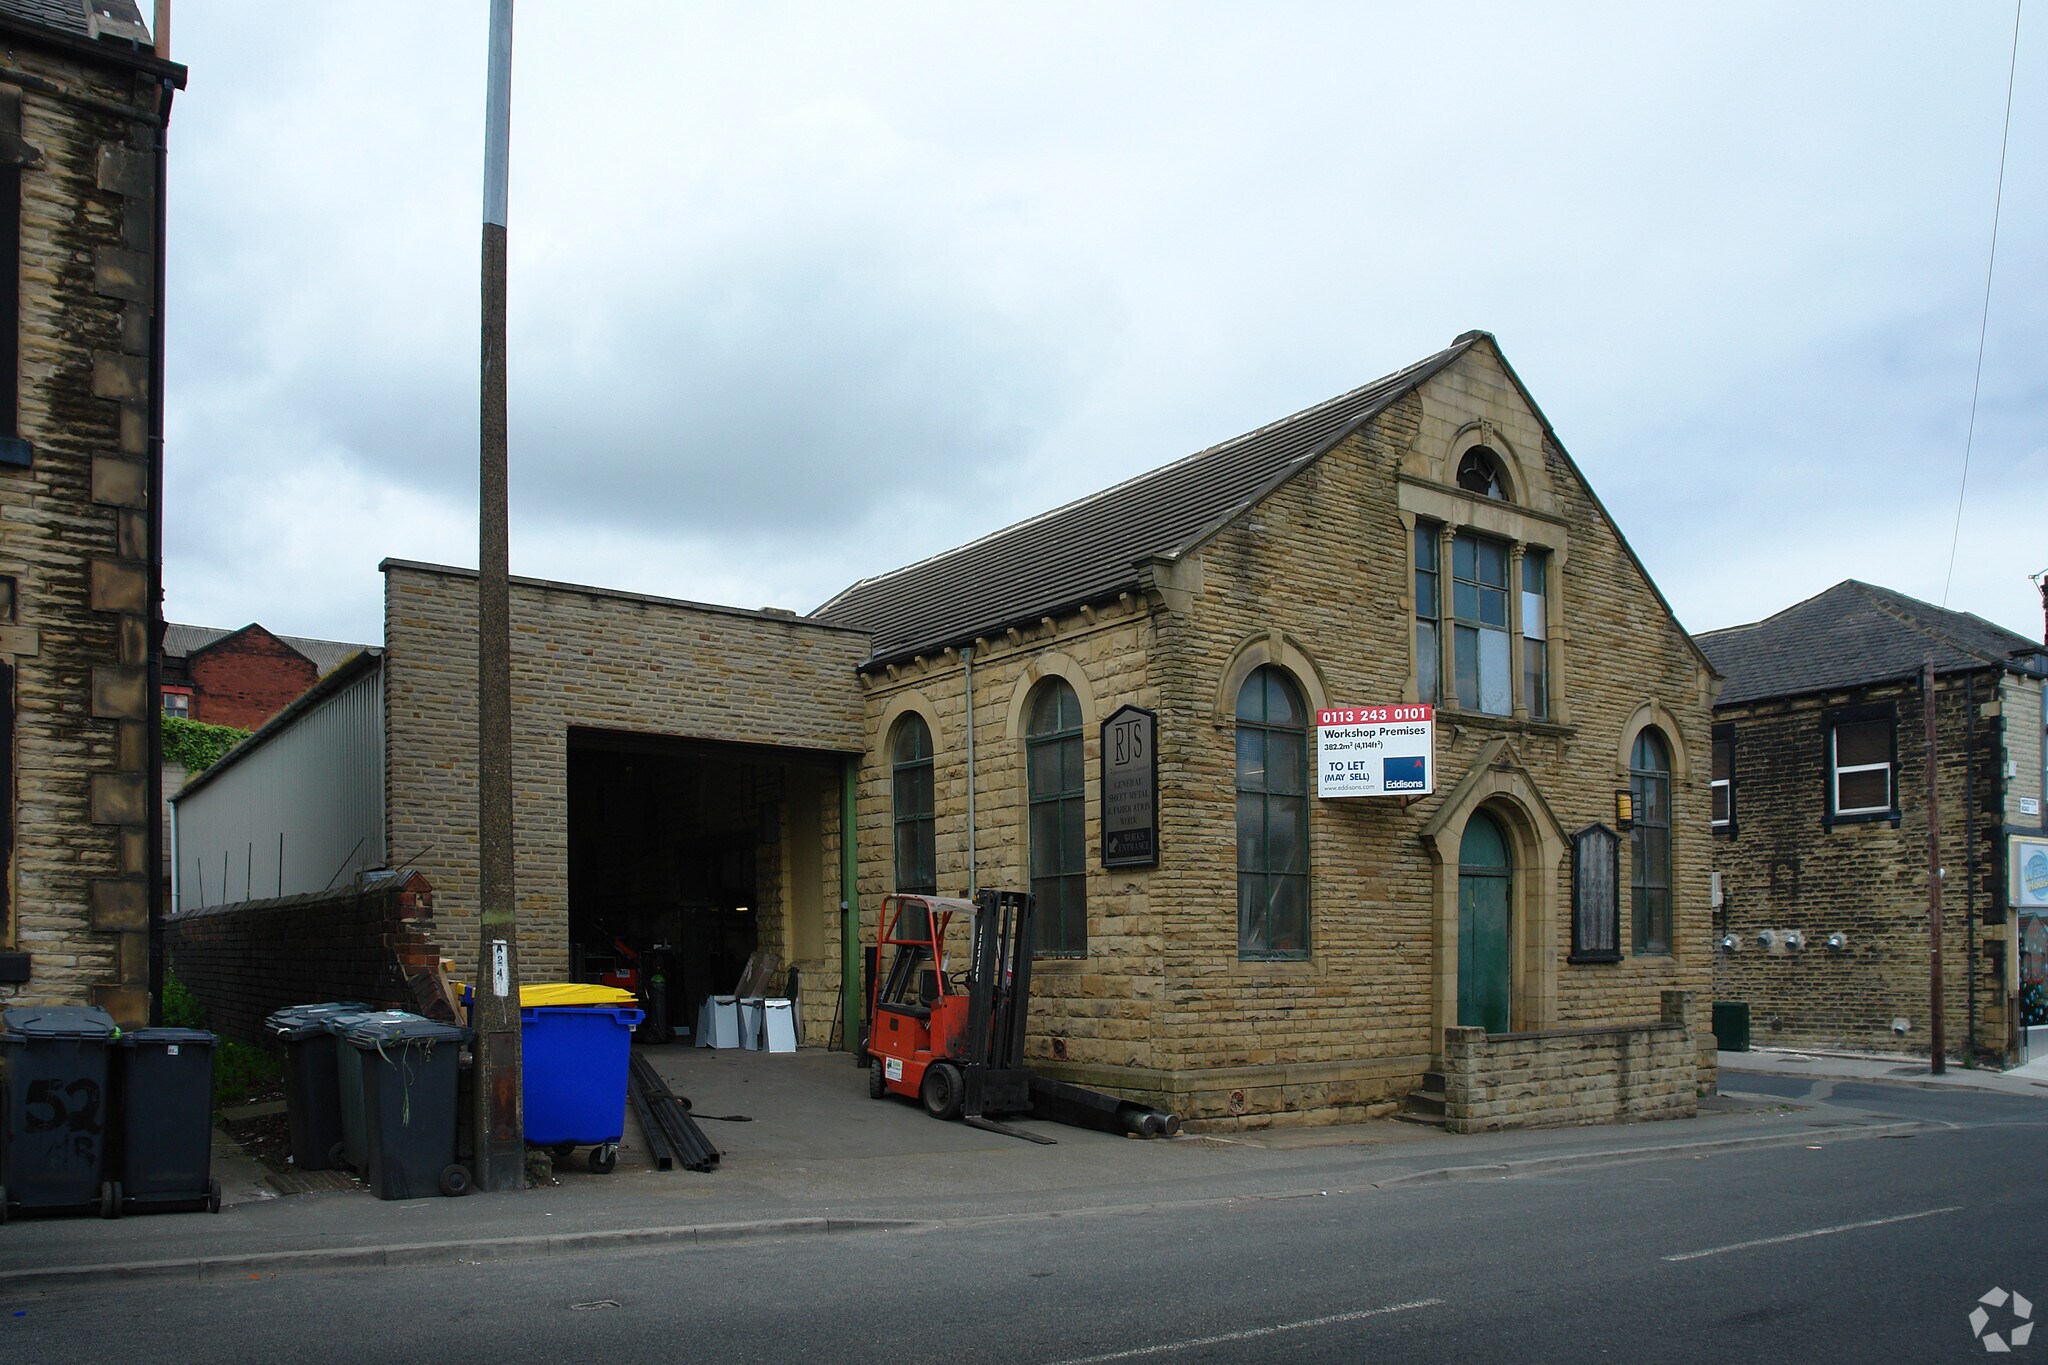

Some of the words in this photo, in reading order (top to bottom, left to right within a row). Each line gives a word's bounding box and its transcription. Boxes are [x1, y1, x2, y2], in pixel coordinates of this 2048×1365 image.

[1322, 711, 1354, 723] 0113
[1360, 709, 1387, 722] 243
[1394, 707, 1425, 720] 0101
[1324, 728, 1376, 739] Workshop
[1379, 726, 1426, 736] Premises
[1329, 761, 1344, 772] TO
[1347, 760, 1365, 771] LET
[1114, 777, 1142, 789] GENERAL
[1324, 774, 1346, 783] (MAY
[1349, 773, 1370, 782] SELL)
[1386, 780, 1424, 789] Eddisons
[1108, 793, 1127, 803] SHEET
[1128, 789, 1149, 801] METAL
[1113, 803, 1151, 815] FABRICATION
[1119, 816, 1138, 825] WORK
[1123, 832, 1145, 842] WORKS
[1118, 842, 1150, 852] ENTRANCE
[24, 1078, 102, 1136] 52
